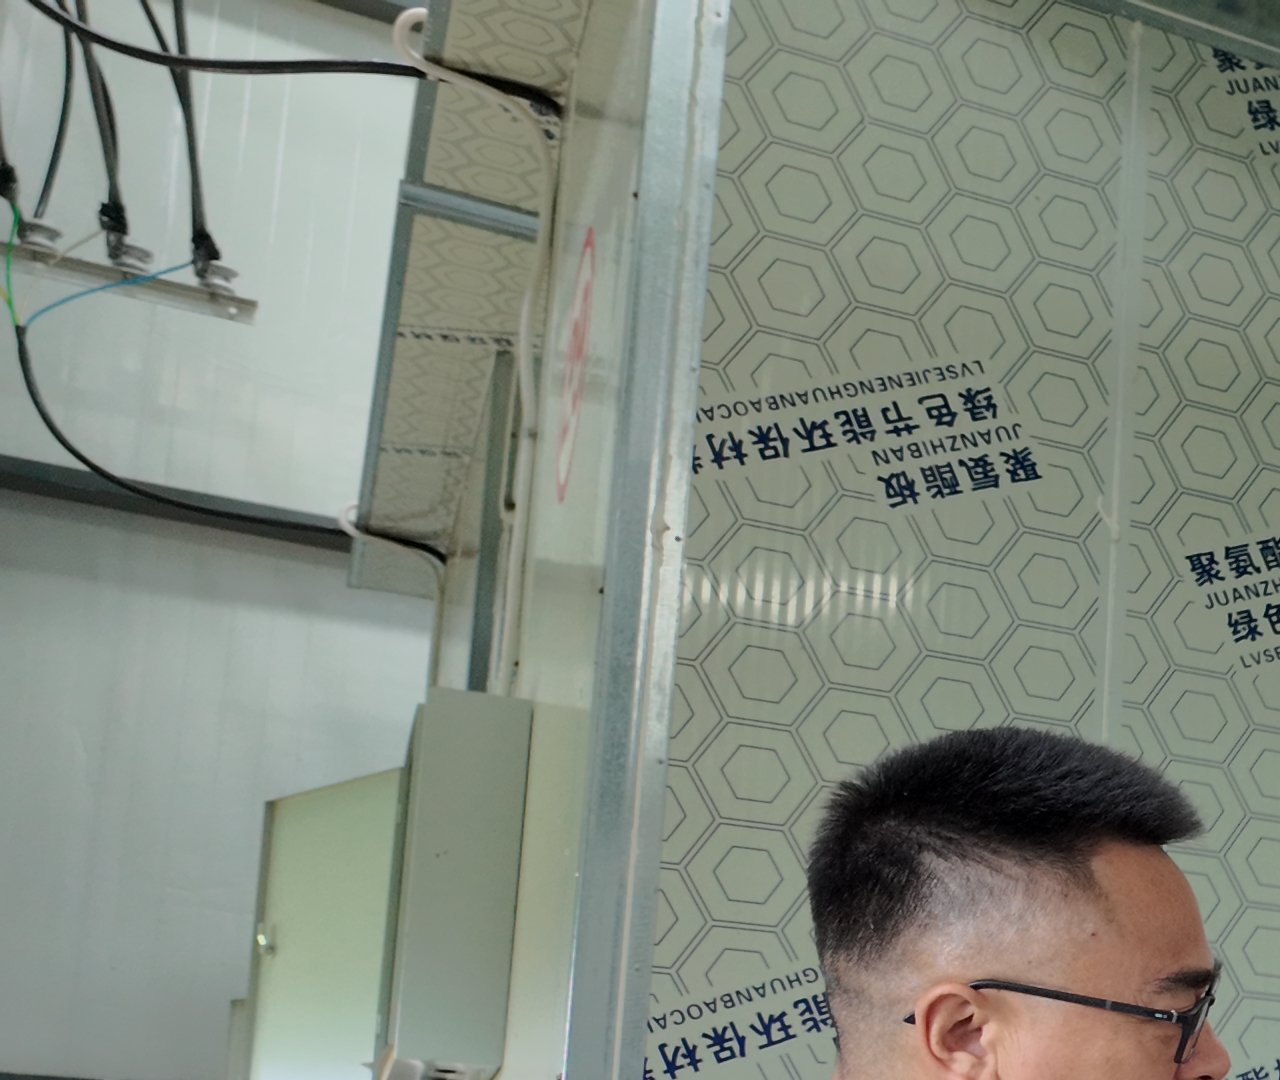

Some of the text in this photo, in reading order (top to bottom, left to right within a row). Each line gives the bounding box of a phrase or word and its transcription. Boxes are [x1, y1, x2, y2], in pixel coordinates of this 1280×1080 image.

[871, 423, 1023, 466] JUANZHIBAN
[878, 446, 1043, 508] 聚氨酯板
